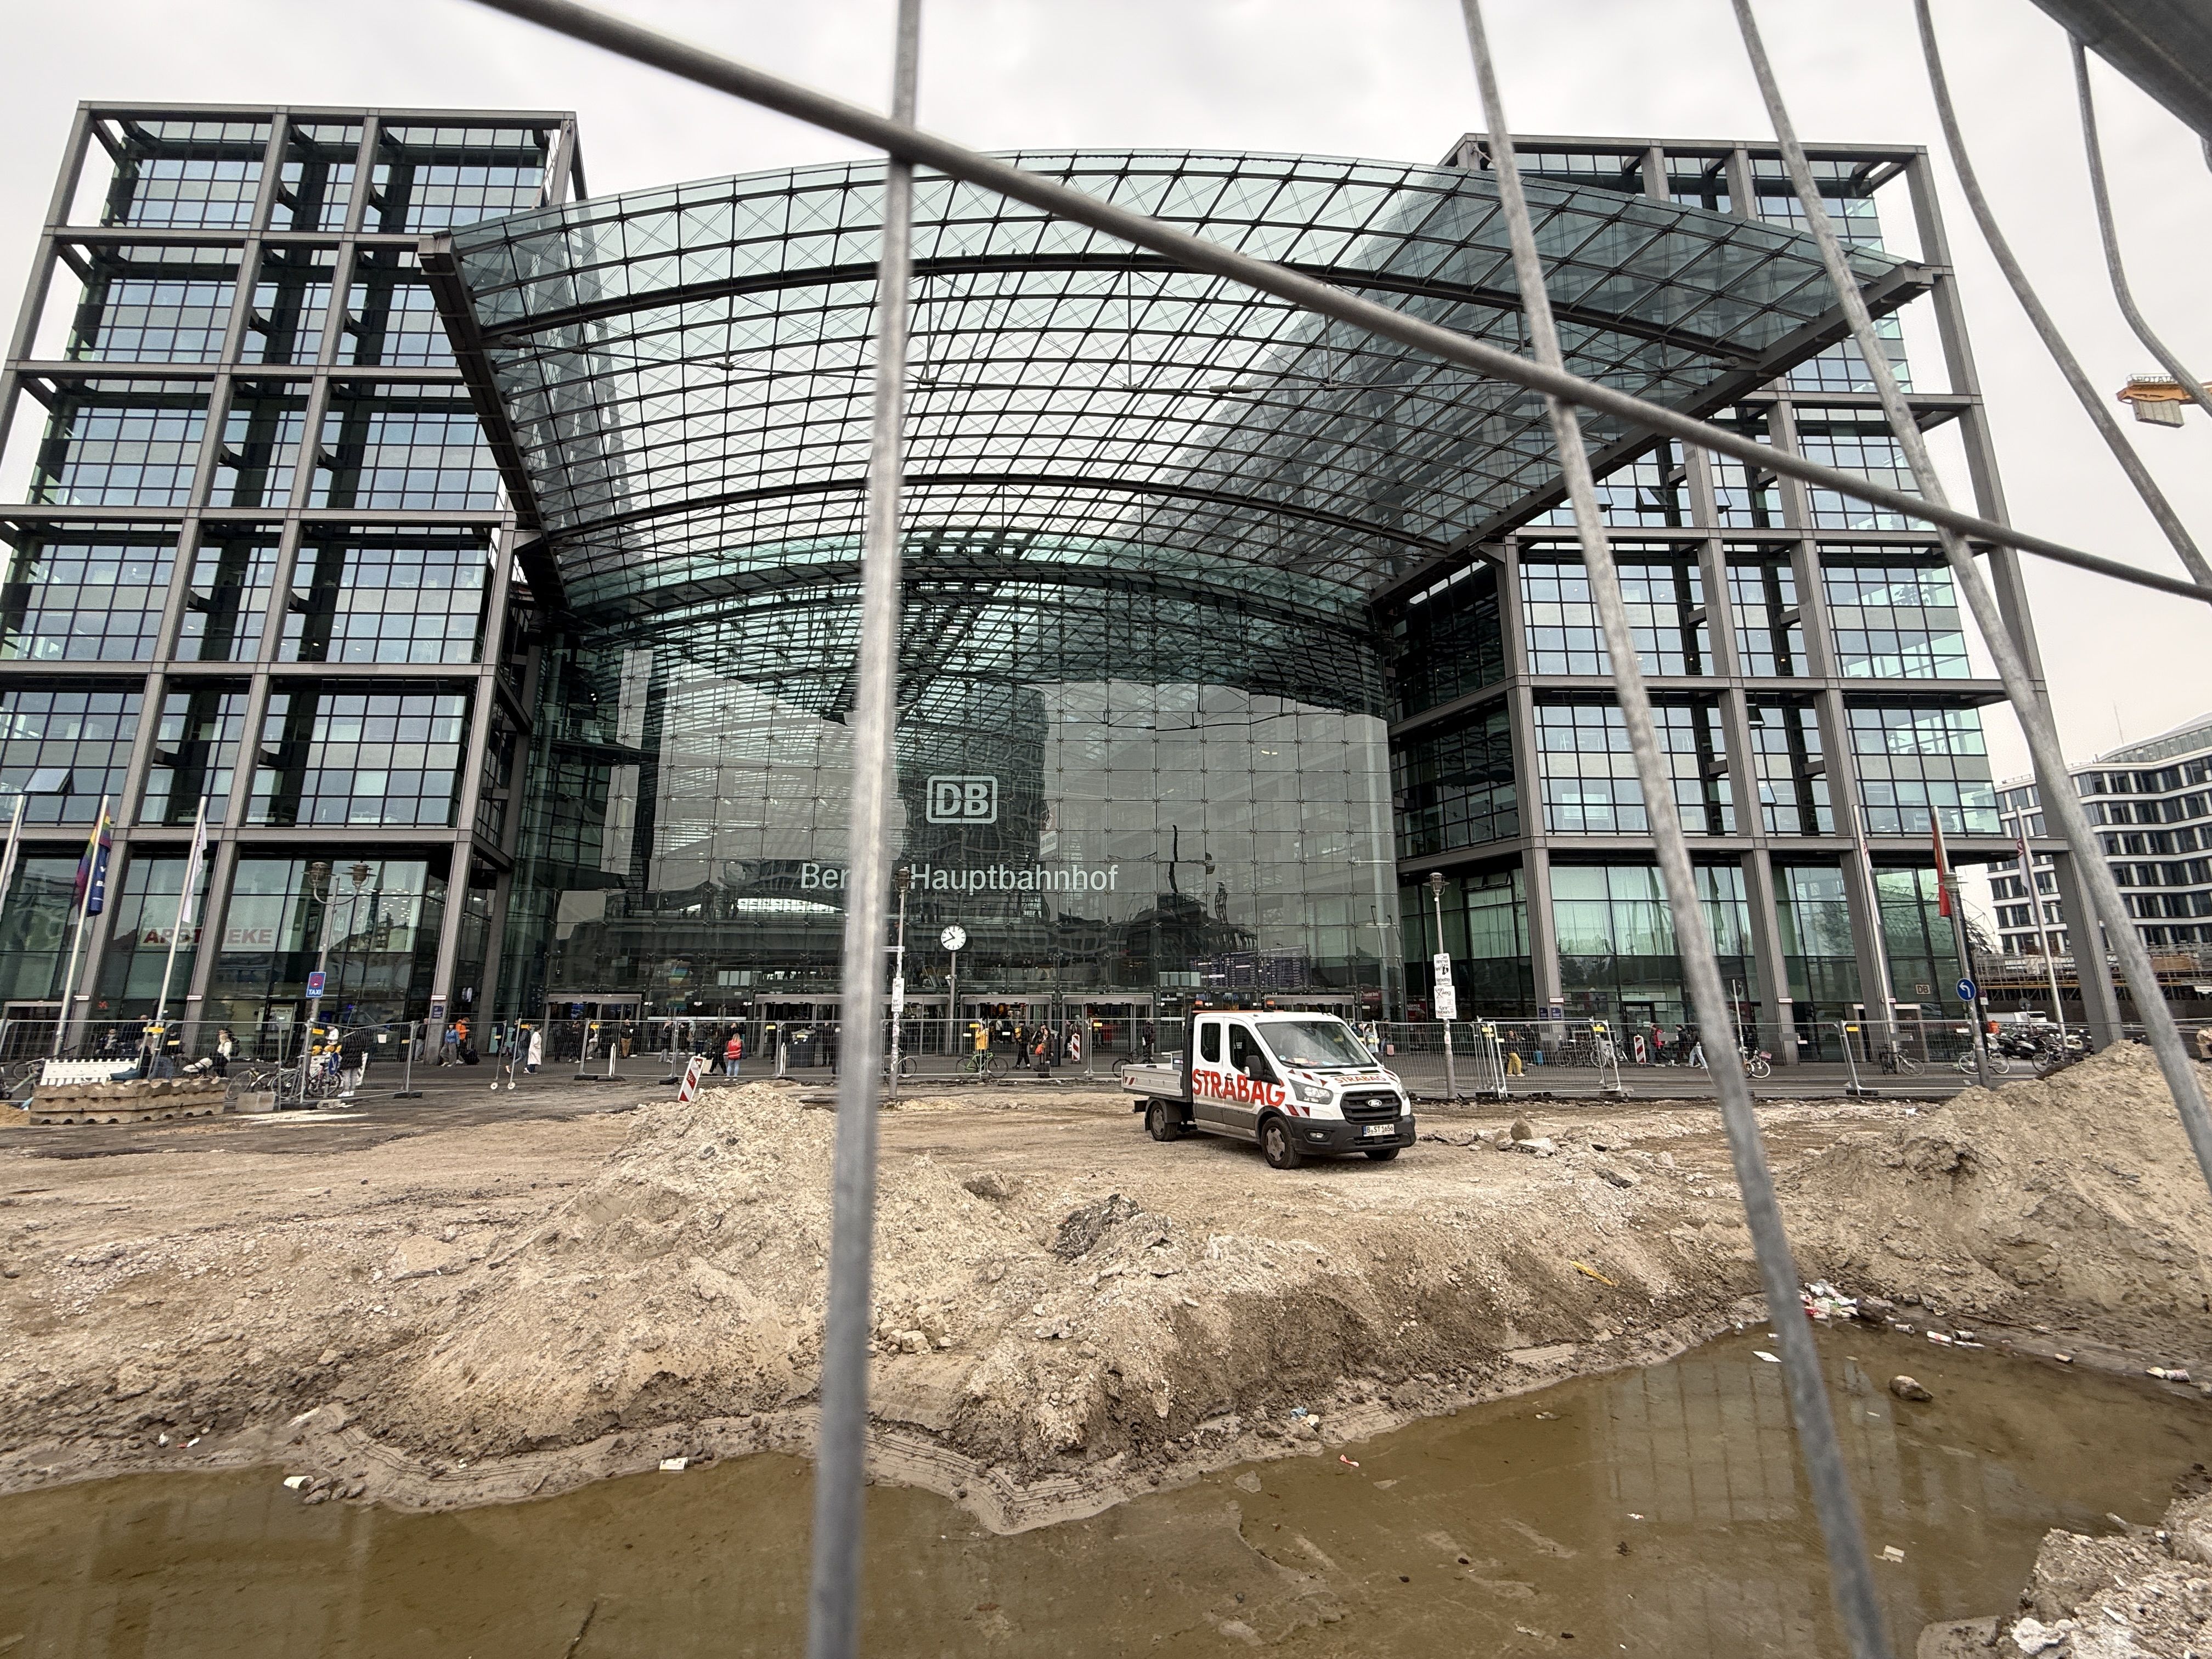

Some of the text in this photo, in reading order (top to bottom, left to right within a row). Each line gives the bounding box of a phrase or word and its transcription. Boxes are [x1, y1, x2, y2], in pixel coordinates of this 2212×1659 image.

[935, 783, 989, 816] DB
[800, 862, 1118, 896] Ber Hauptbahnhof
[1917, 985, 1929, 994] DB
[1193, 1068, 1286, 1107] STRABAG
[1334, 1075, 1387, 1084] STRABAG
